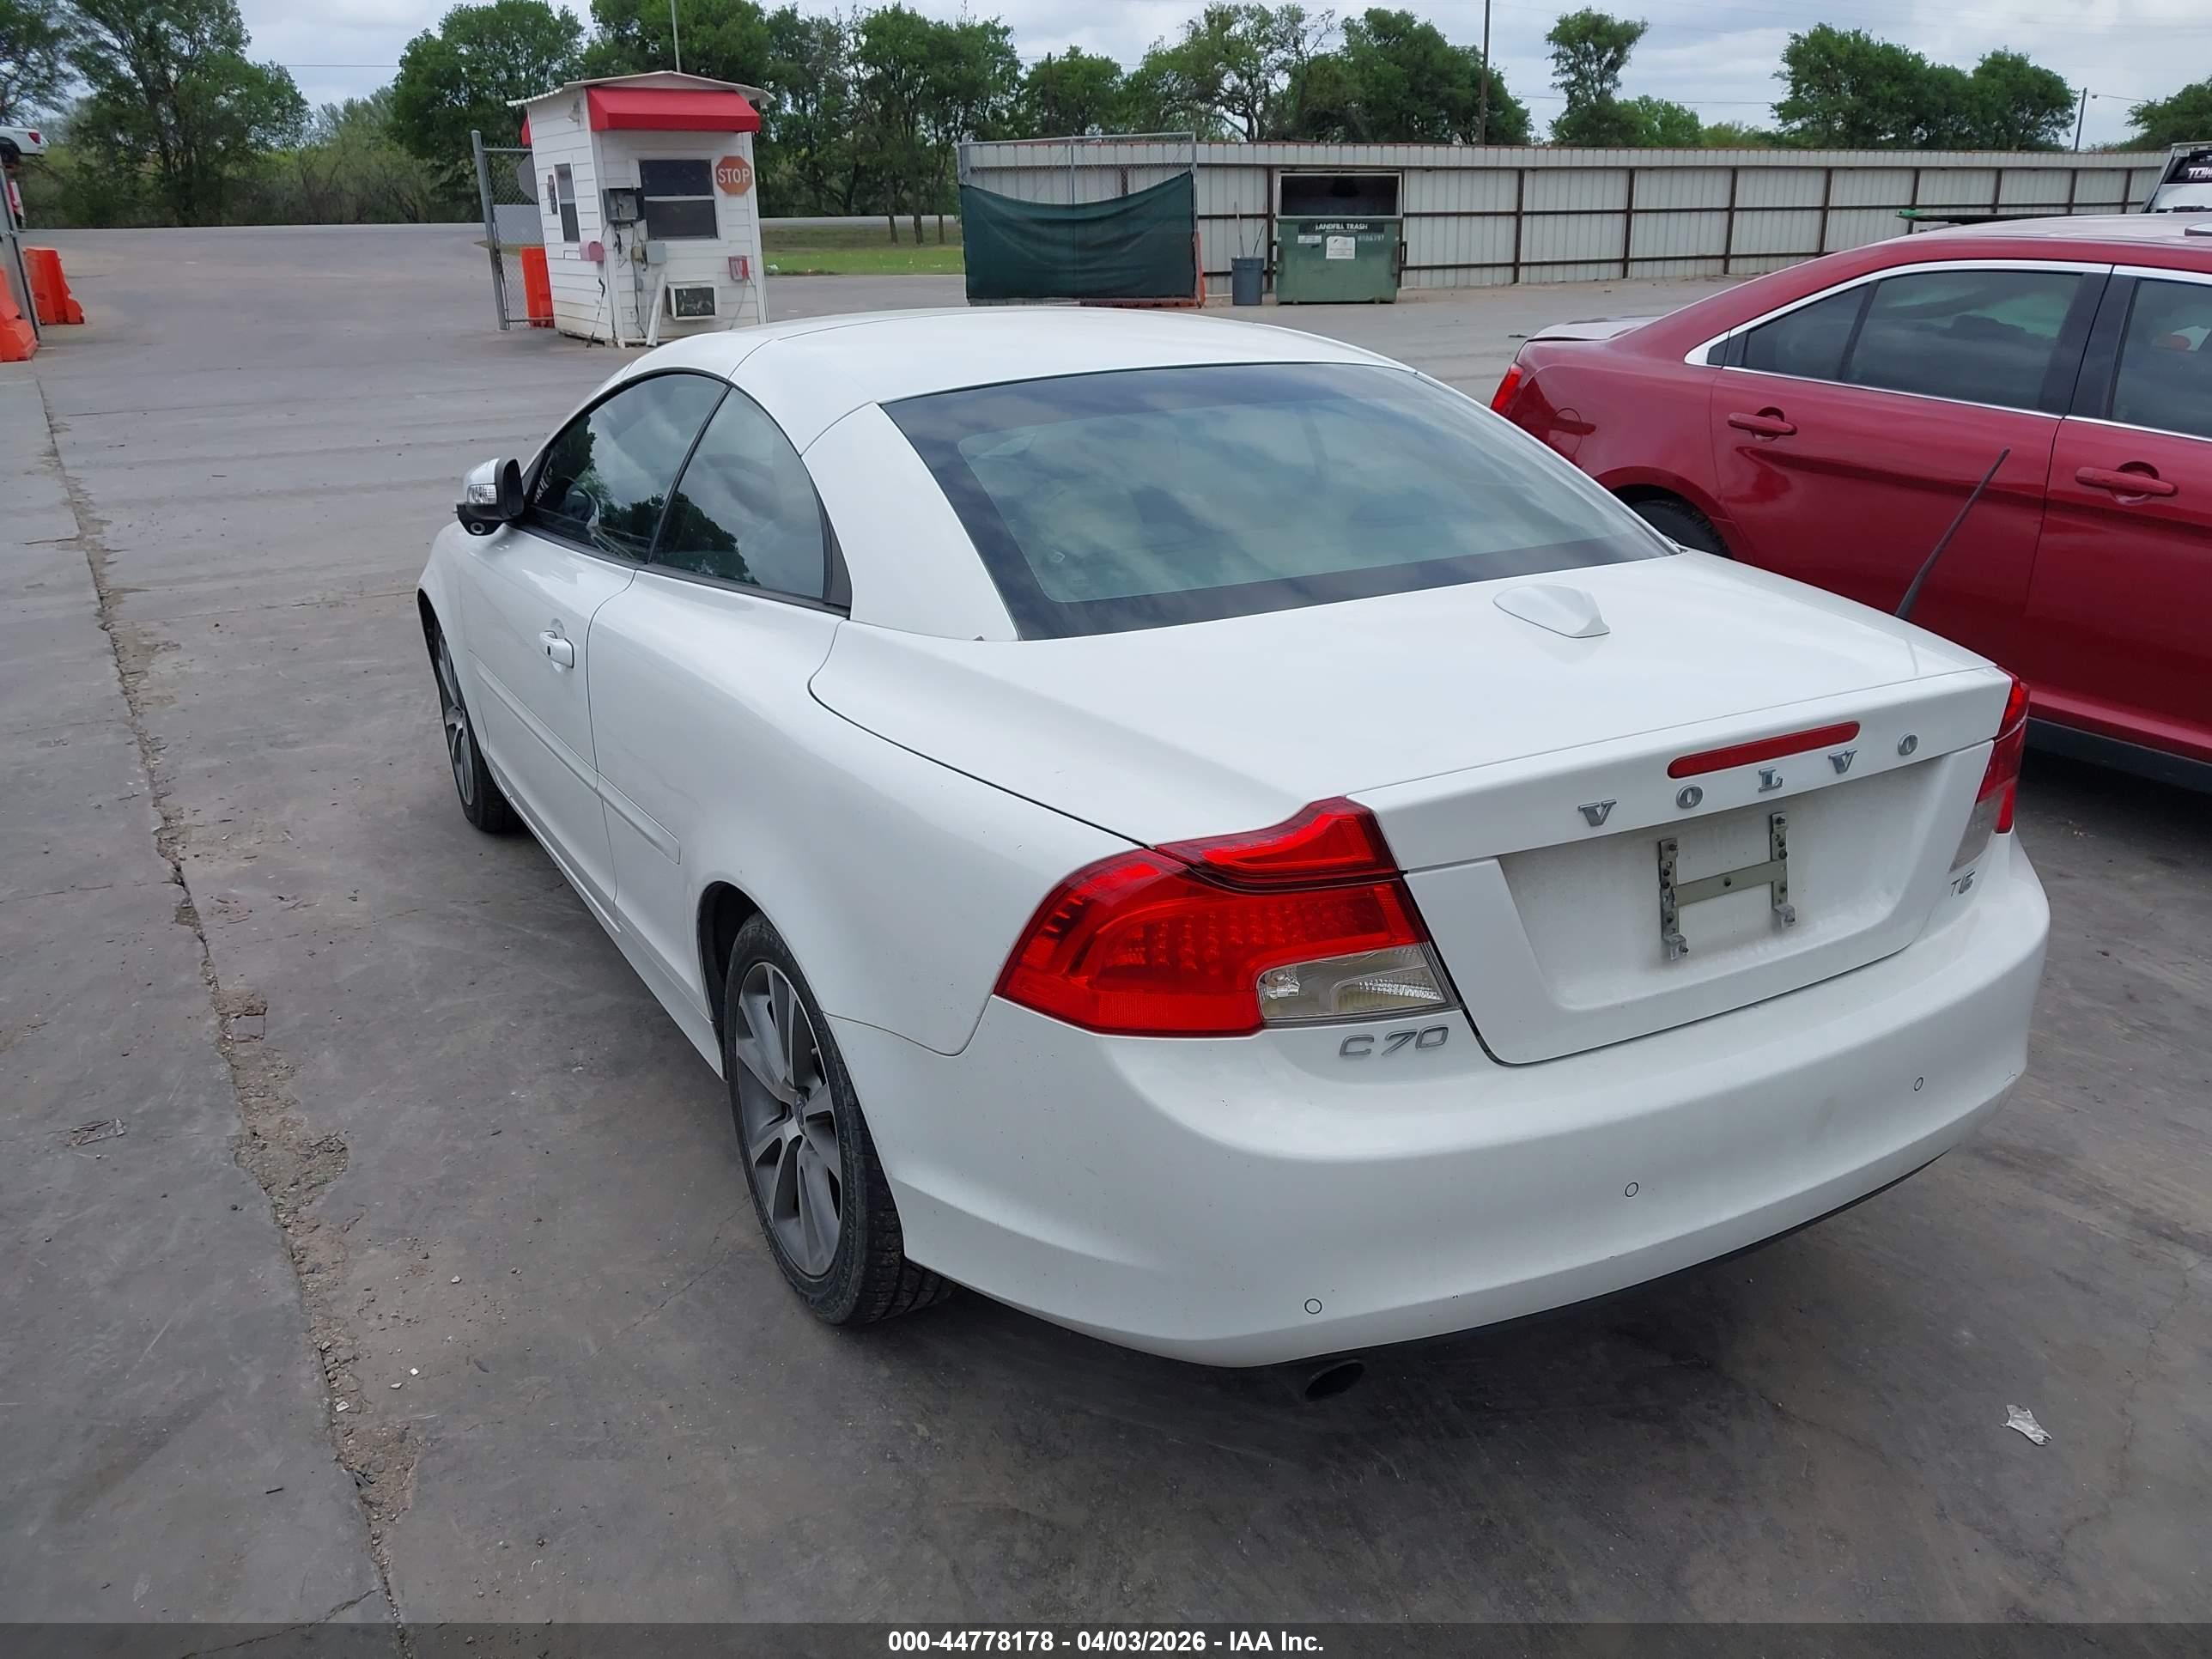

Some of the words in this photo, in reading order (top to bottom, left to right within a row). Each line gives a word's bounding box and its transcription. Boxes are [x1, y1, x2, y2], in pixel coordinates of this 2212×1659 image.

[718, 167, 750, 184] STOP
[1577, 732, 1919, 827] VOLVO
[1339, 1024, 1449, 1058] C70
